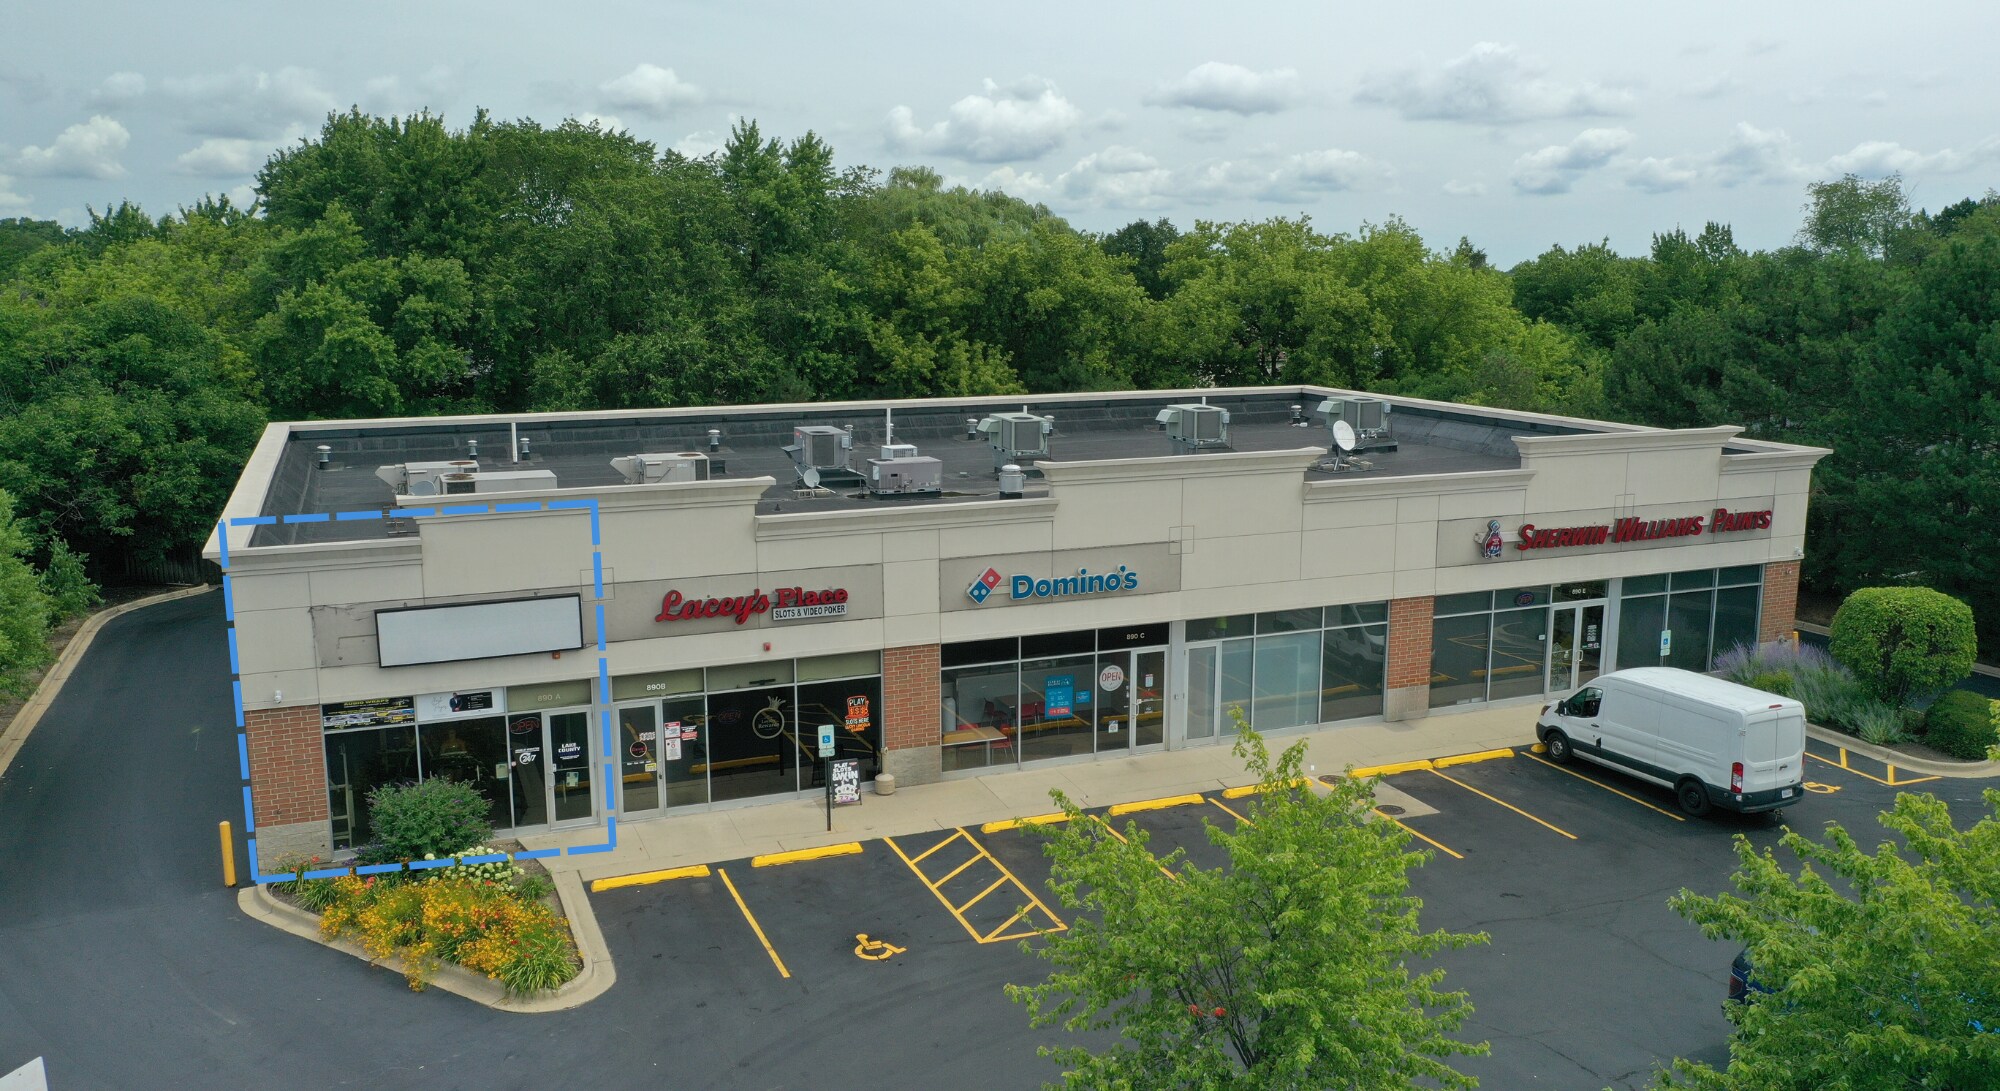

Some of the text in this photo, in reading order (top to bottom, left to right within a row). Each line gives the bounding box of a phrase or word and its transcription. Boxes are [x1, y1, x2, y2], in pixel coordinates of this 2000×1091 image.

[1709, 508, 1772, 533] PAINTS
[1010, 564, 1138, 600] Domino's
[655, 586, 849, 625] Lacey's Place
[775, 605, 845, 618] SLOTS & VIDEO POKER
[1101, 672, 1121, 682] OPEN
[537, 694, 553, 702] 890
[849, 698, 865, 706] PLAY
[510, 720, 540, 731] OPEN
